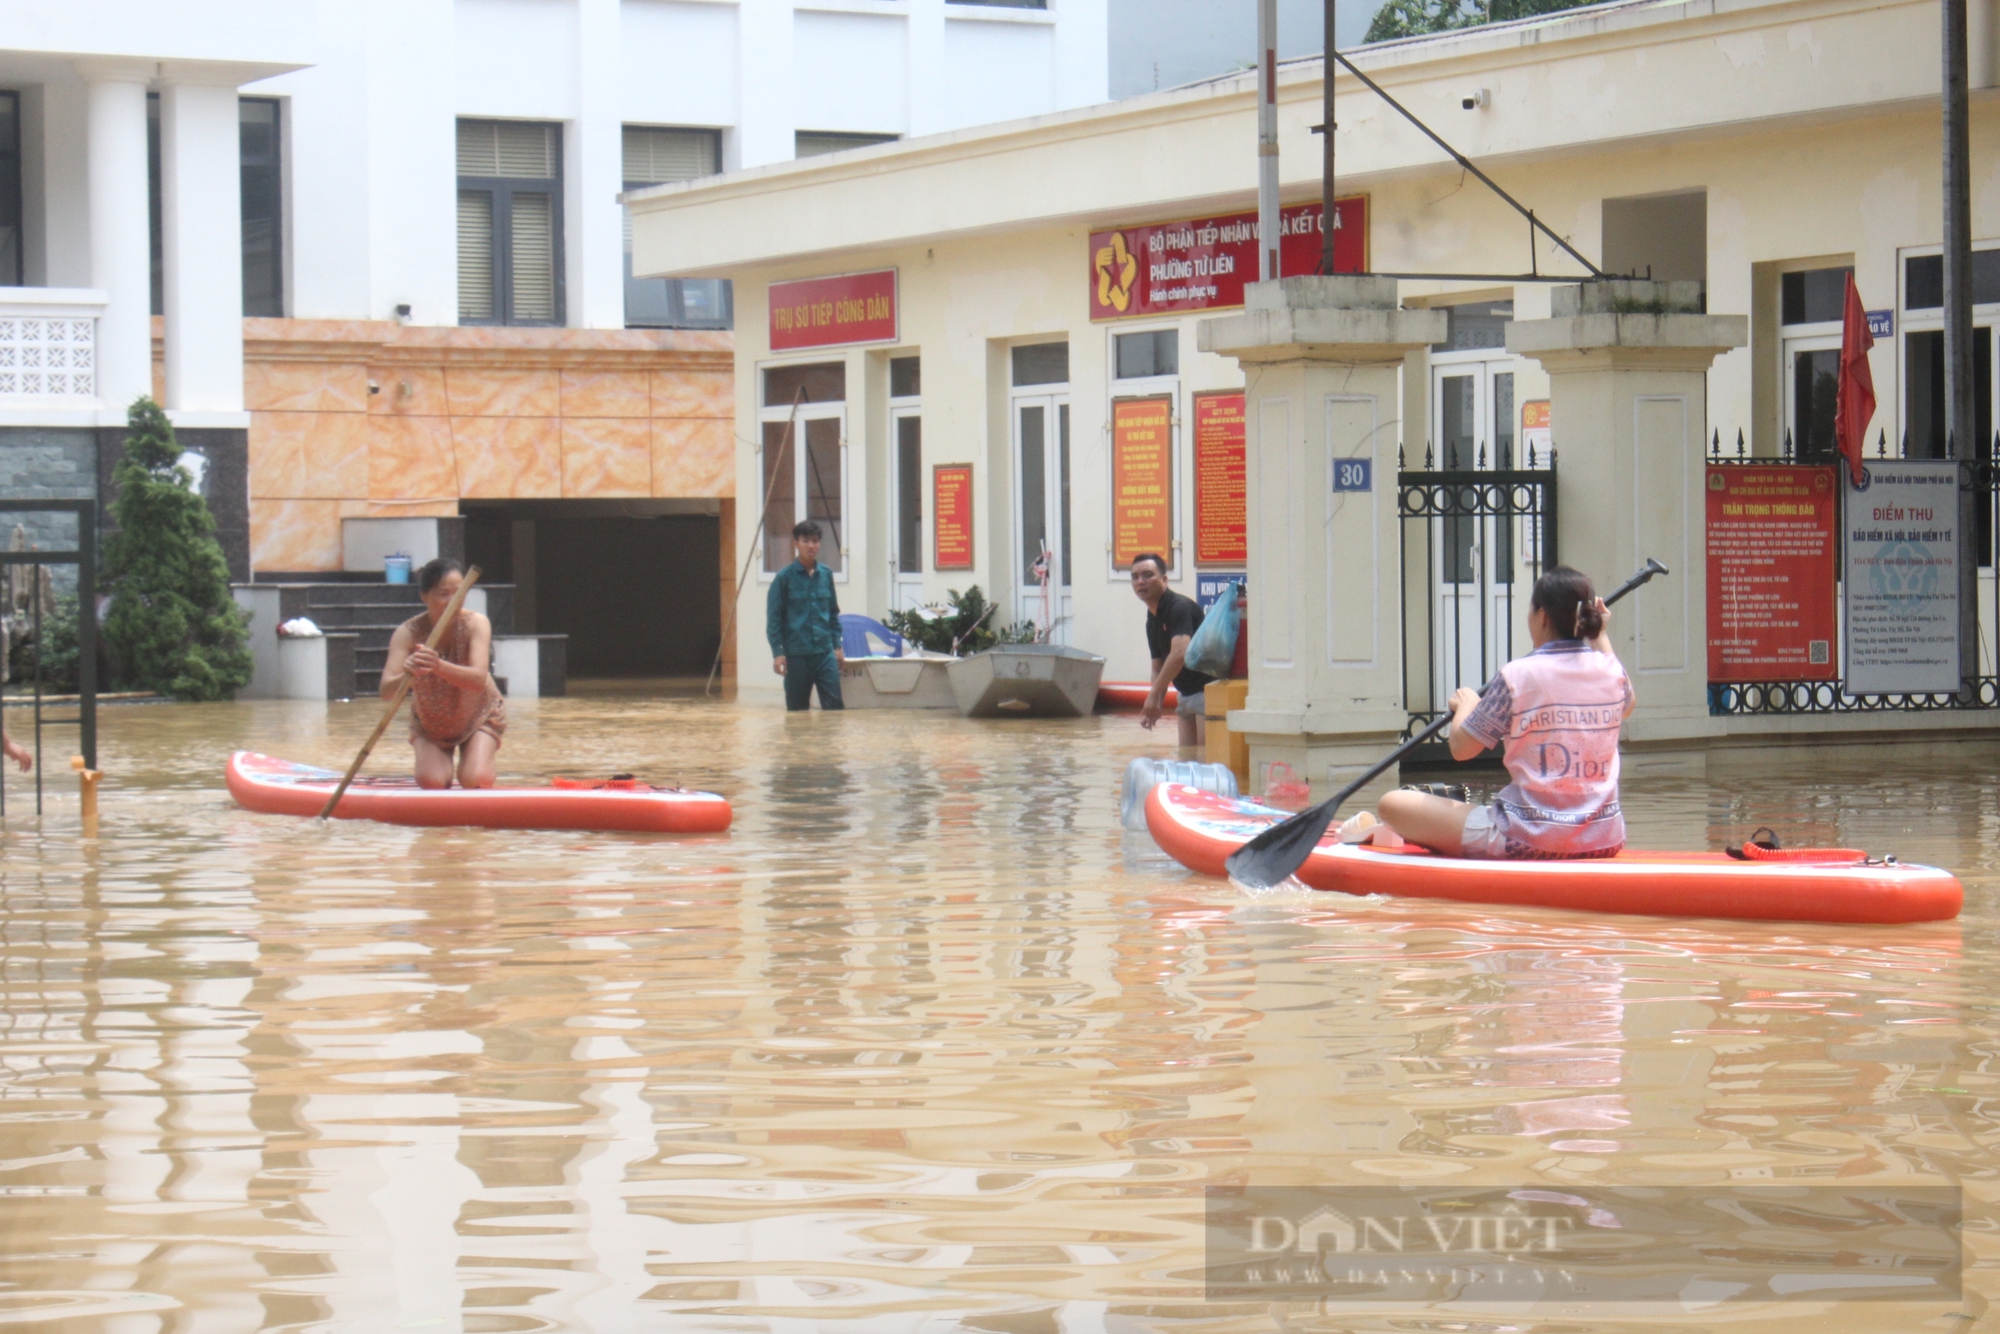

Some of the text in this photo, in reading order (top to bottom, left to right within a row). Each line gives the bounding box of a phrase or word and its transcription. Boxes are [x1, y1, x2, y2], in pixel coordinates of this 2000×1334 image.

[1150, 231, 1164, 254] BỘ
[1166, 226, 1194, 252] PHẬN
[1197, 221, 1218, 246] TIẾP
[1220, 220, 1250, 246] NHẬN
[1292, 208, 1314, 234] KẾT
[1150, 256, 1192, 282] PHƯỜNG
[1210, 254, 1234, 275] LIÊN
[775, 292, 890, 334] TRỤ SỞ TIẾP CÔNG DÂN
[1880, 320, 1890, 334] VỆ
[1341, 464, 1363, 486] 30
[1722, 502, 1814, 517] TRÂN TRỌNG THÔNG BÁO
[1873, 501, 1933, 520] ĐIỂM THU
[1853, 528, 1865, 543] BẢO
[1867, 528, 1882, 543] HIỂM
[1885, 528, 1893, 543] XÃ
[1907, 528, 1920, 543] BẢO
[1921, 528, 1937, 543] HIỂM
[1939, 531, 1943, 542] Y
[1944, 528, 1952, 543] TẾ
[1201, 582, 1216, 596] KHU
[1520, 710, 1598, 731] CHRISTIAN
[1536, 743, 1608, 778] Dior
[1552, 814, 1576, 822] DIOR
